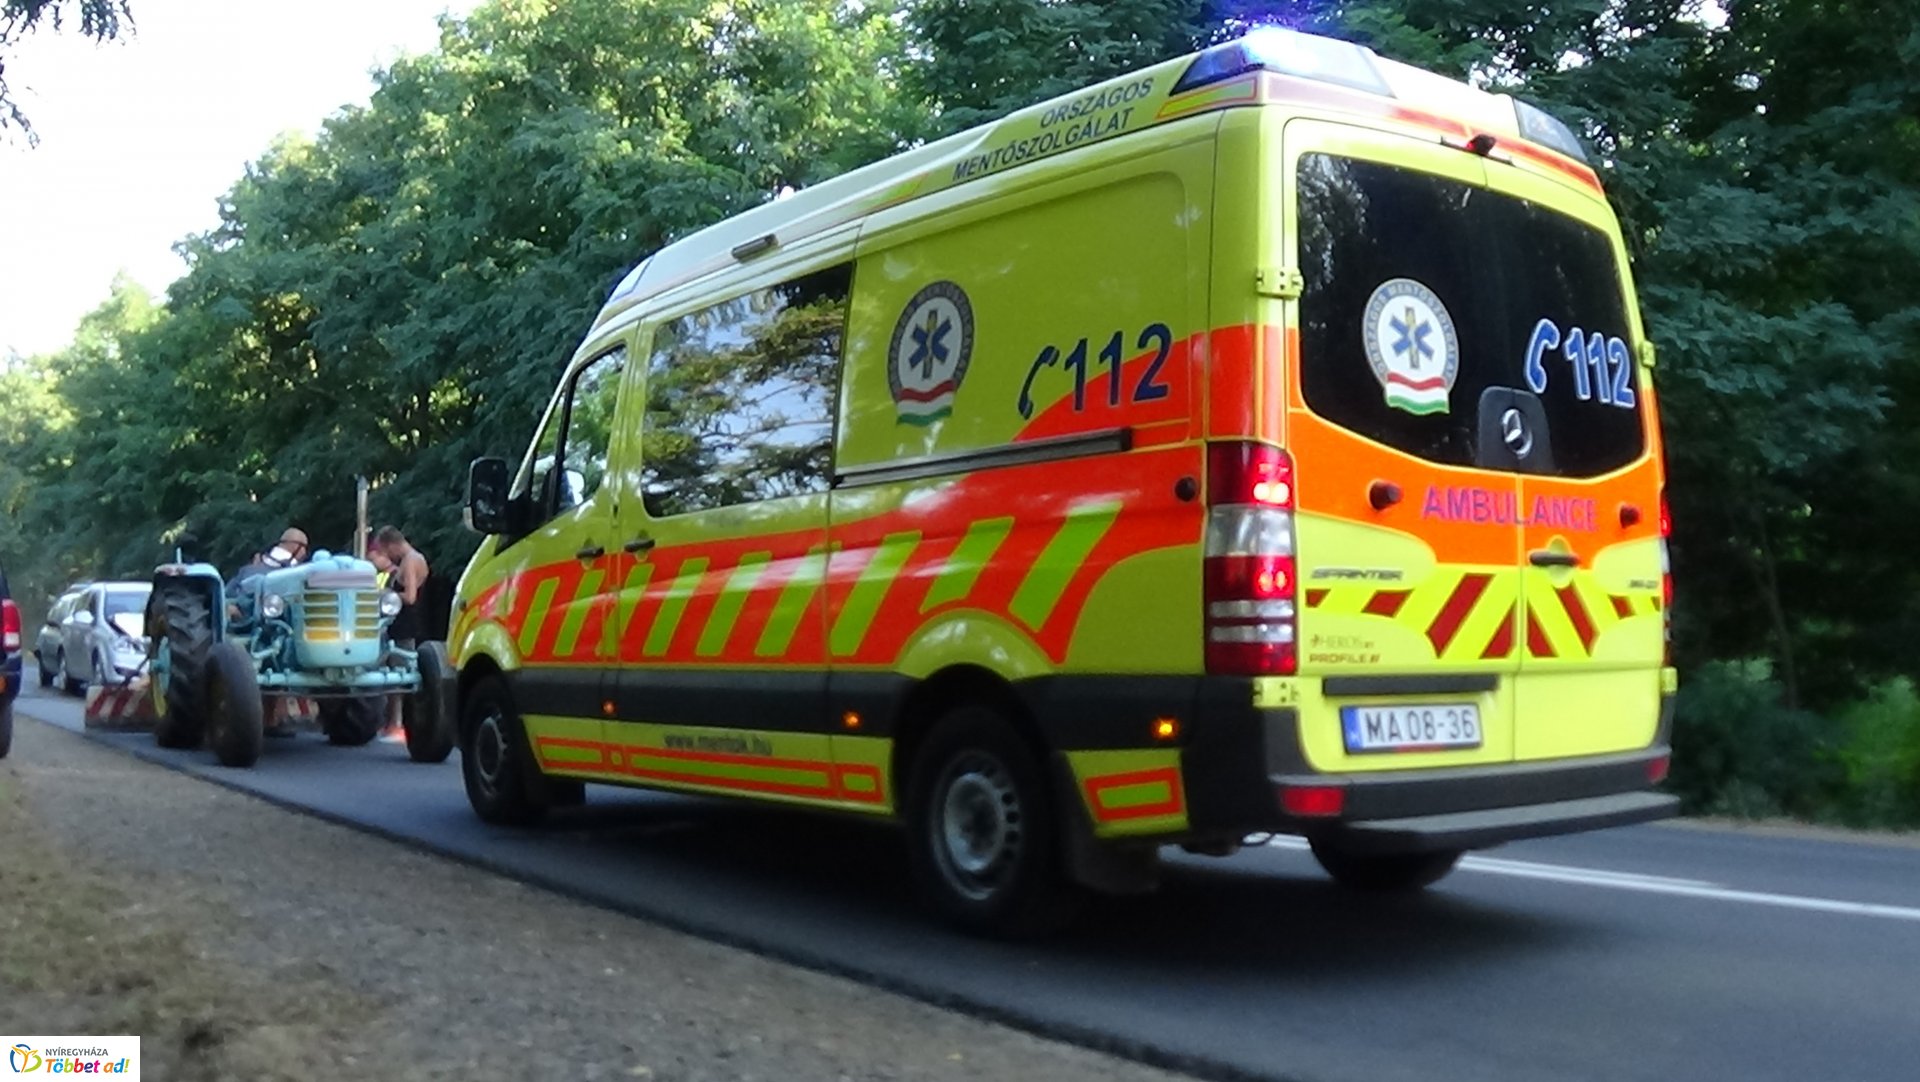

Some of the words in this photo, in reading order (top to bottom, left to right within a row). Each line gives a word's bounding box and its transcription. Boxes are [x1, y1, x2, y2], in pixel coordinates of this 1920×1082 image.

[1040, 78, 1154, 128] ORSZÁGOS
[953, 108, 1134, 181] MENTŐSZOLGÁLAT
[1064, 322, 1172, 411] 112
[1564, 327, 1635, 408] 112
[1422, 486, 1599, 532] AMBULANCE
[1311, 567, 1403, 581] SPRINTER
